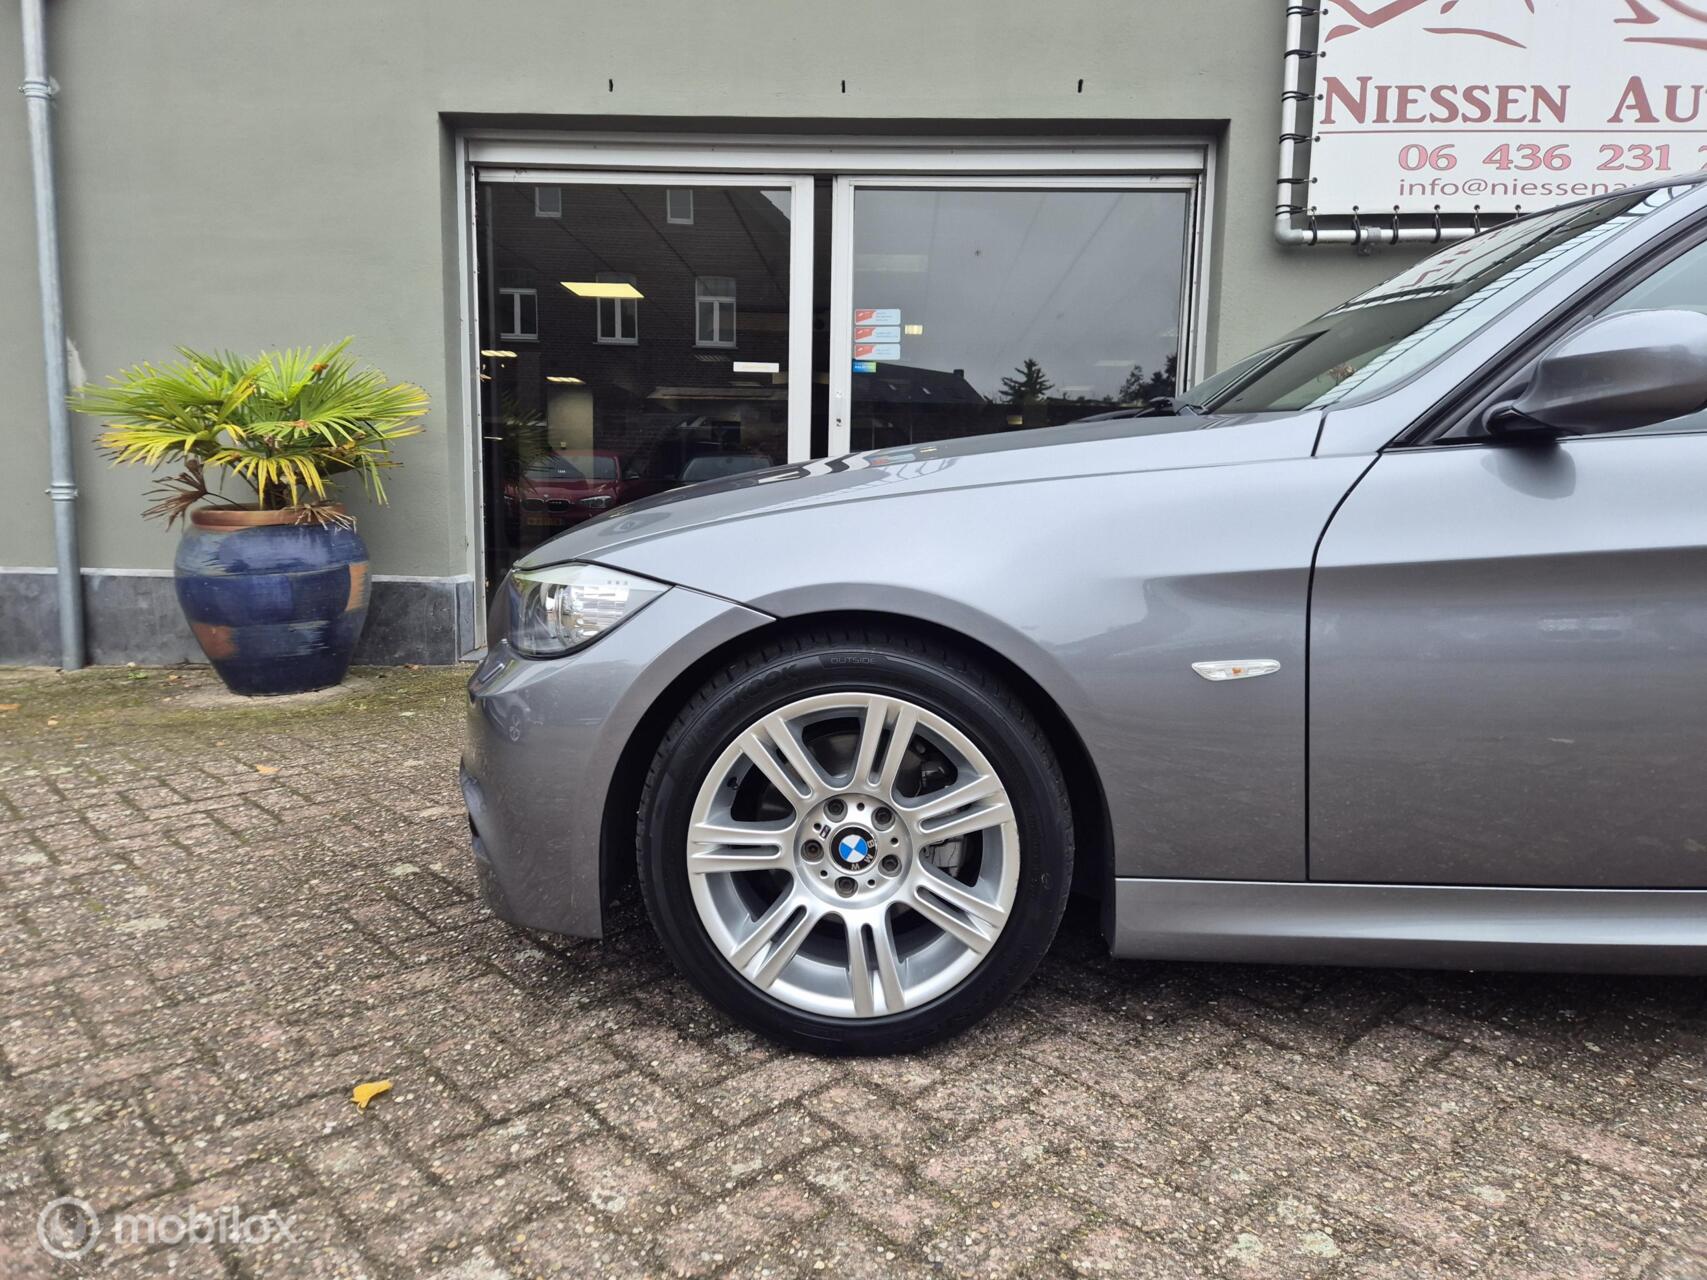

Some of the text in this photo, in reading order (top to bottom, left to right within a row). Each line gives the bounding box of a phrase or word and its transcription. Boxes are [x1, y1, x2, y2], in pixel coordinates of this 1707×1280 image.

[1319, 75, 1707, 125] NIESSEN AU
[1398, 143, 1458, 171] 06
[1482, 143, 1572, 171] 436
[1596, 143, 1671, 171] 231
[1399, 177, 1637, 197] info@niessena
[830, 656, 877, 665] OUTSIDE
[851, 839, 875, 871] BMW
